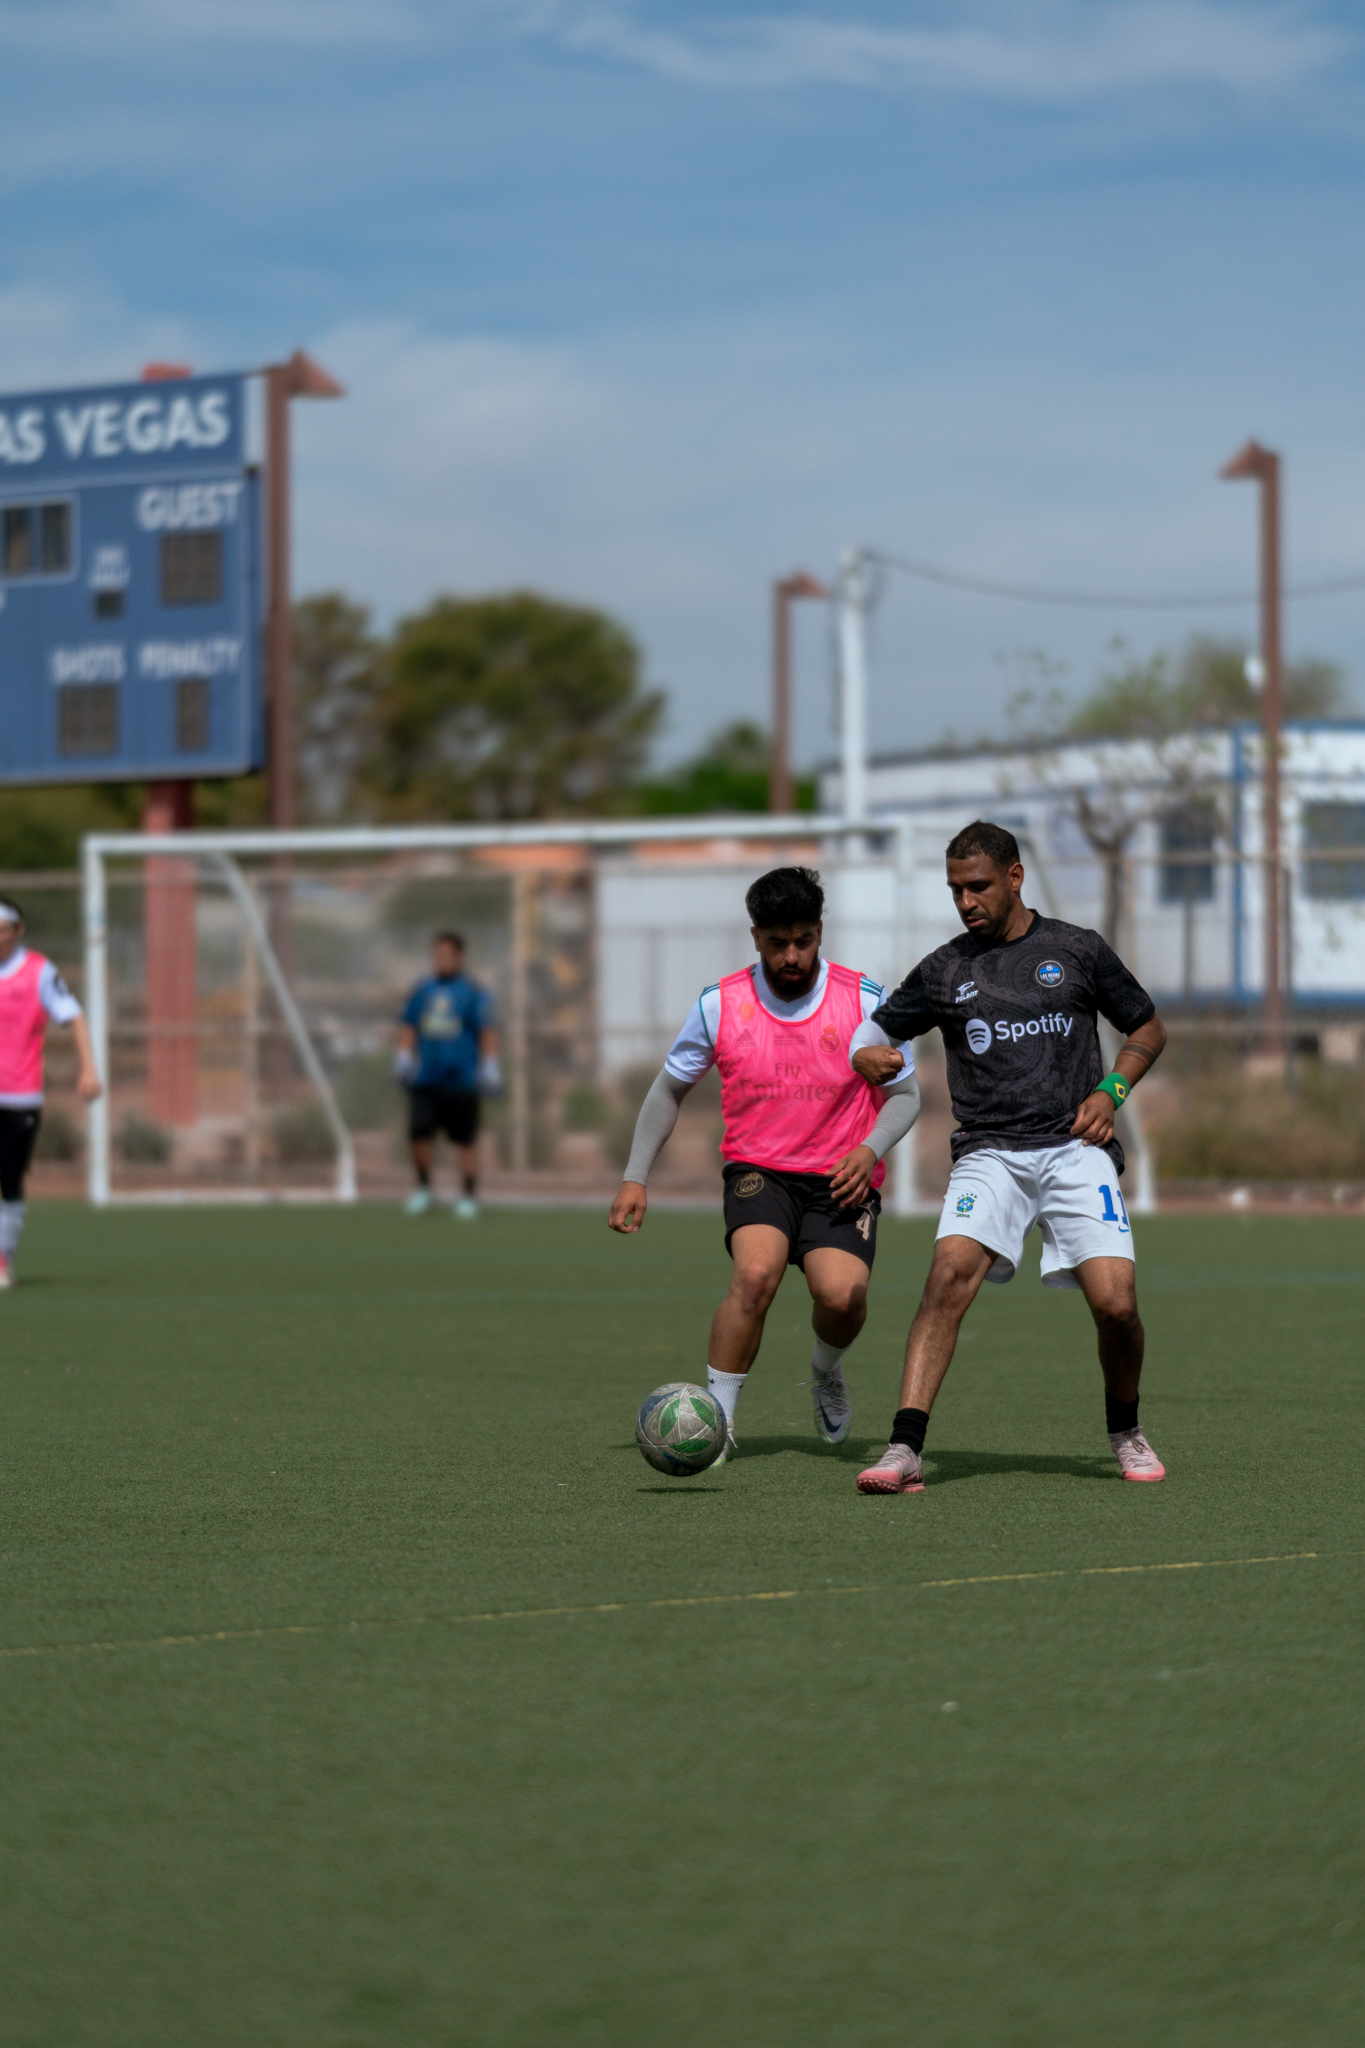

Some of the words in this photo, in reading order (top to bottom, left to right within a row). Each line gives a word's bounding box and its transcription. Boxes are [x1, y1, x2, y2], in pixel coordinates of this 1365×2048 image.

[54, 391, 231, 459] VEGAS
[138, 481, 241, 530] GUEST
[994, 1012, 1073, 1042] Spotify
[774, 1062, 801, 1078] Fly
[739, 1079, 839, 1101] Emirates
[855, 1211, 870, 1240] 4
